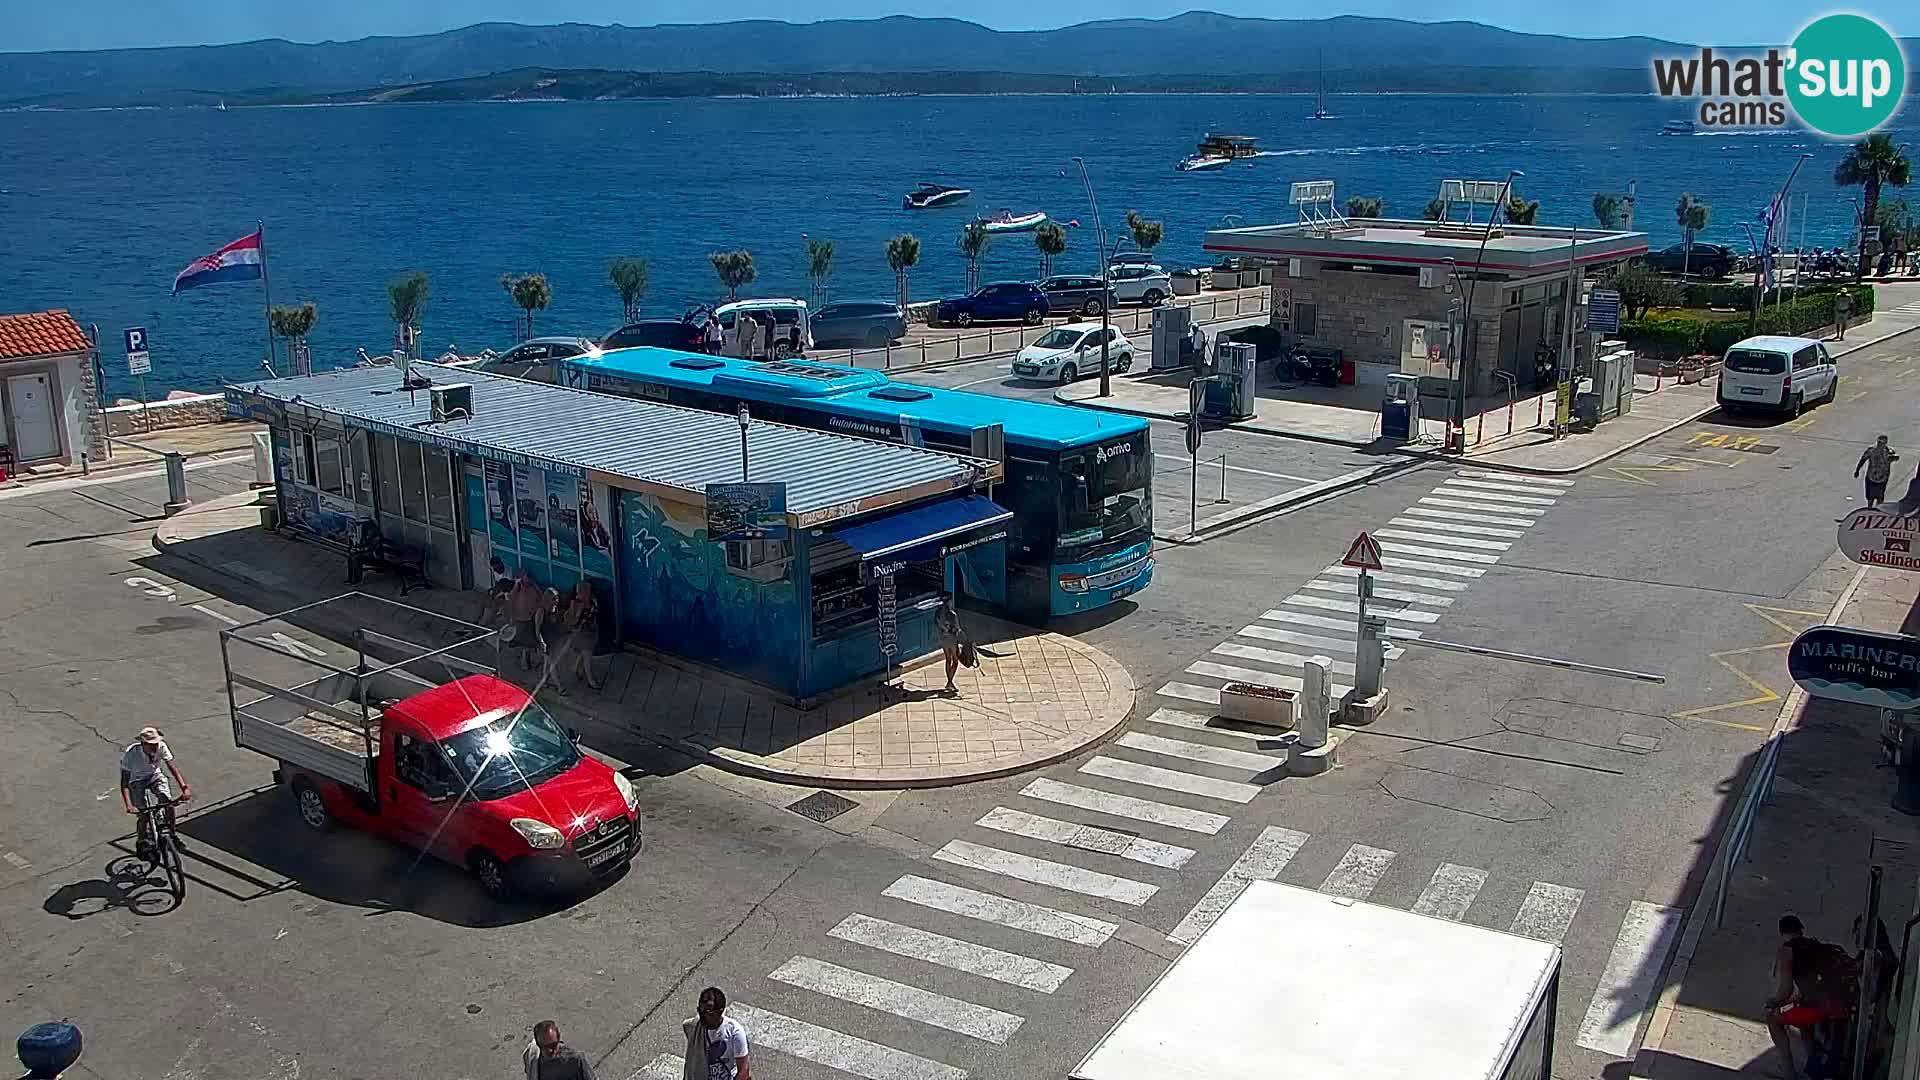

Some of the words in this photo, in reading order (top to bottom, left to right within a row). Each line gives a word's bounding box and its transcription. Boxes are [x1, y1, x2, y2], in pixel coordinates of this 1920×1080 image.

[130, 331, 142, 350] P
[494, 449, 526, 465] STATION
[529, 457, 554, 471] TICKET
[555, 462, 582, 477] OFFICE
[1829, 661, 1866, 675] caffe
[1871, 666, 1897, 680] bar
